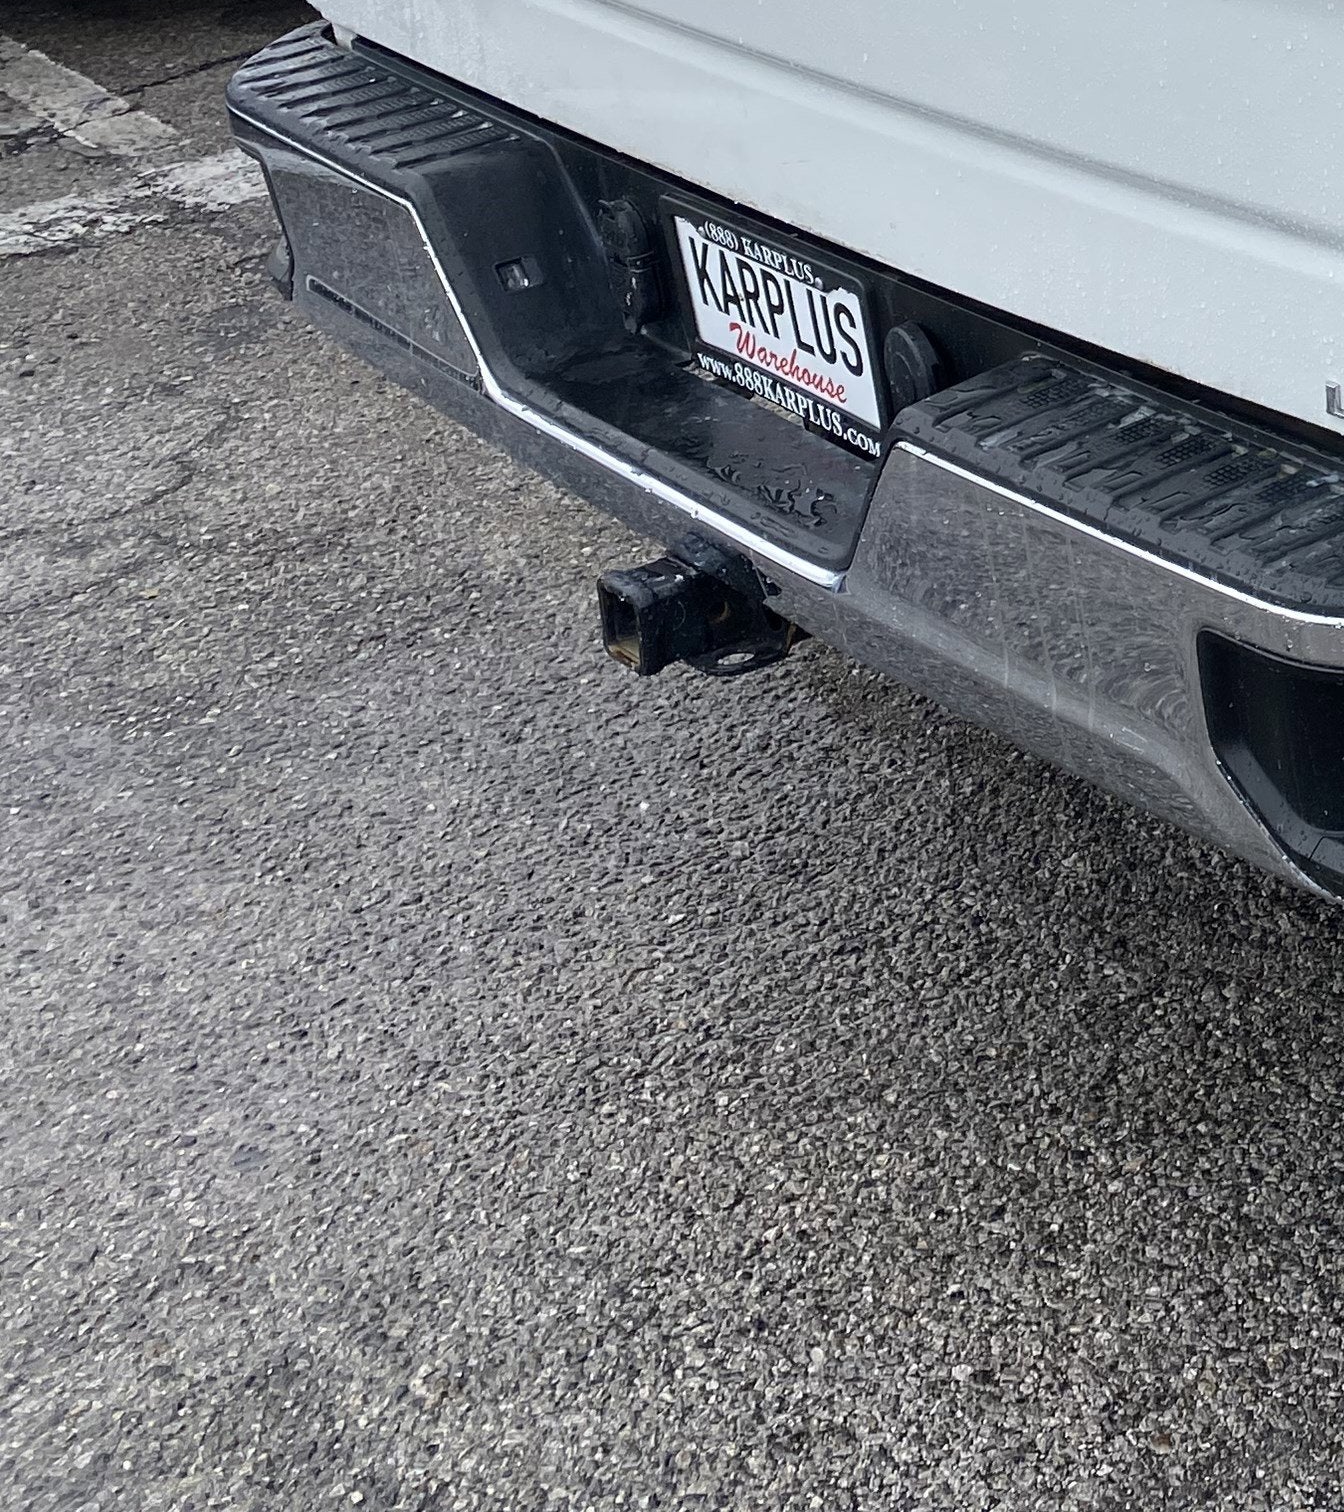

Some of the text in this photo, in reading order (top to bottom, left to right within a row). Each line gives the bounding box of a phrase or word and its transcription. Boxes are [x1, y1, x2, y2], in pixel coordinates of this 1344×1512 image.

[703, 220, 815, 285] (888) KARPLUS
[688, 235, 864, 378] KARPLUS
[729, 322, 848, 404] Warehouse
